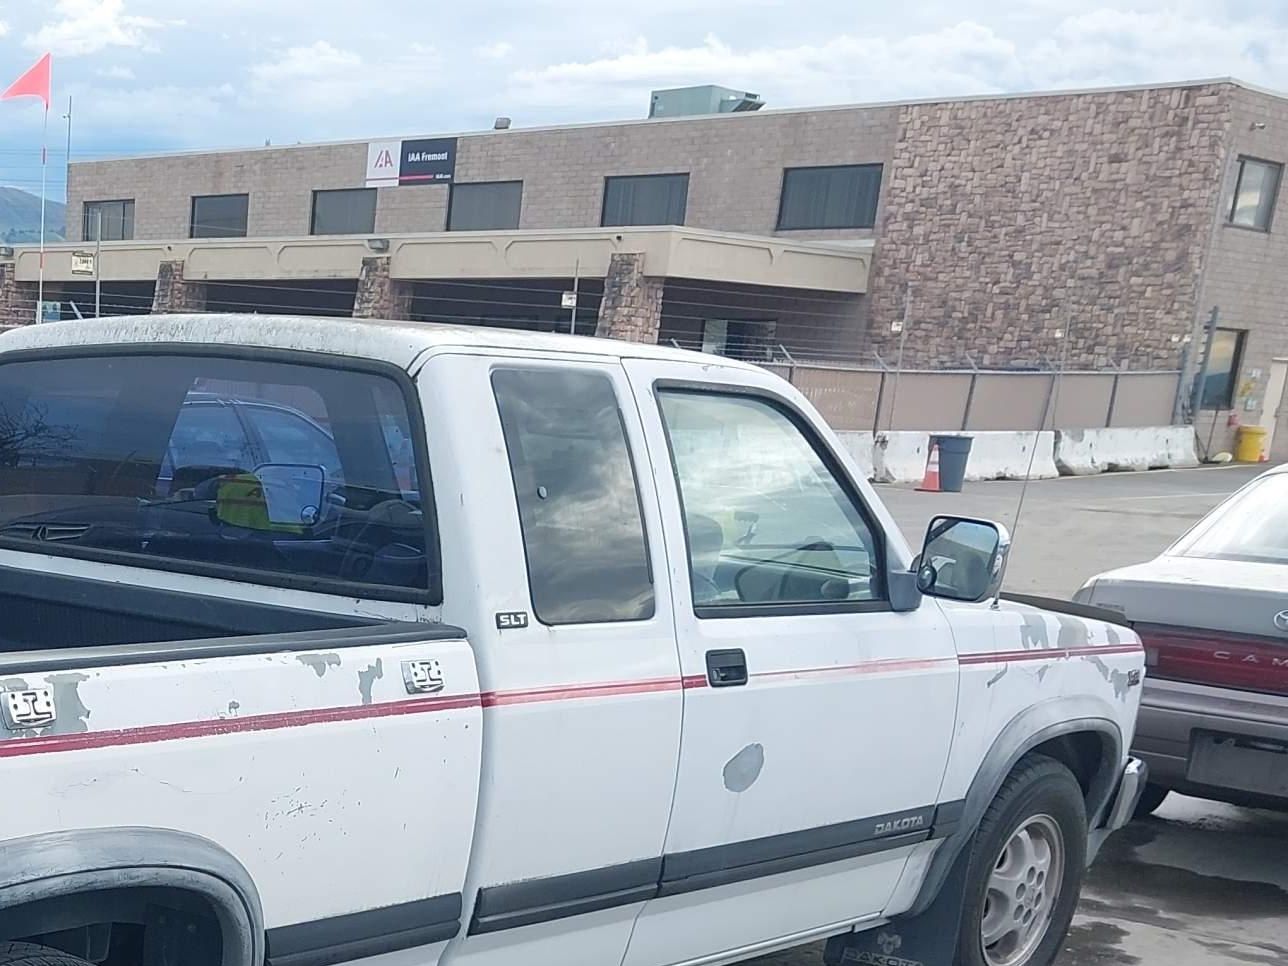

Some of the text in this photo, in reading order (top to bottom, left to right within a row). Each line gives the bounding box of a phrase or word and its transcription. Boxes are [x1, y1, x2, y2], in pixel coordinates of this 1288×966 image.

[421, 151, 448, 161] Fremont
[499, 614, 526, 625] SLT
[874, 815, 923, 835] DAKOTA
